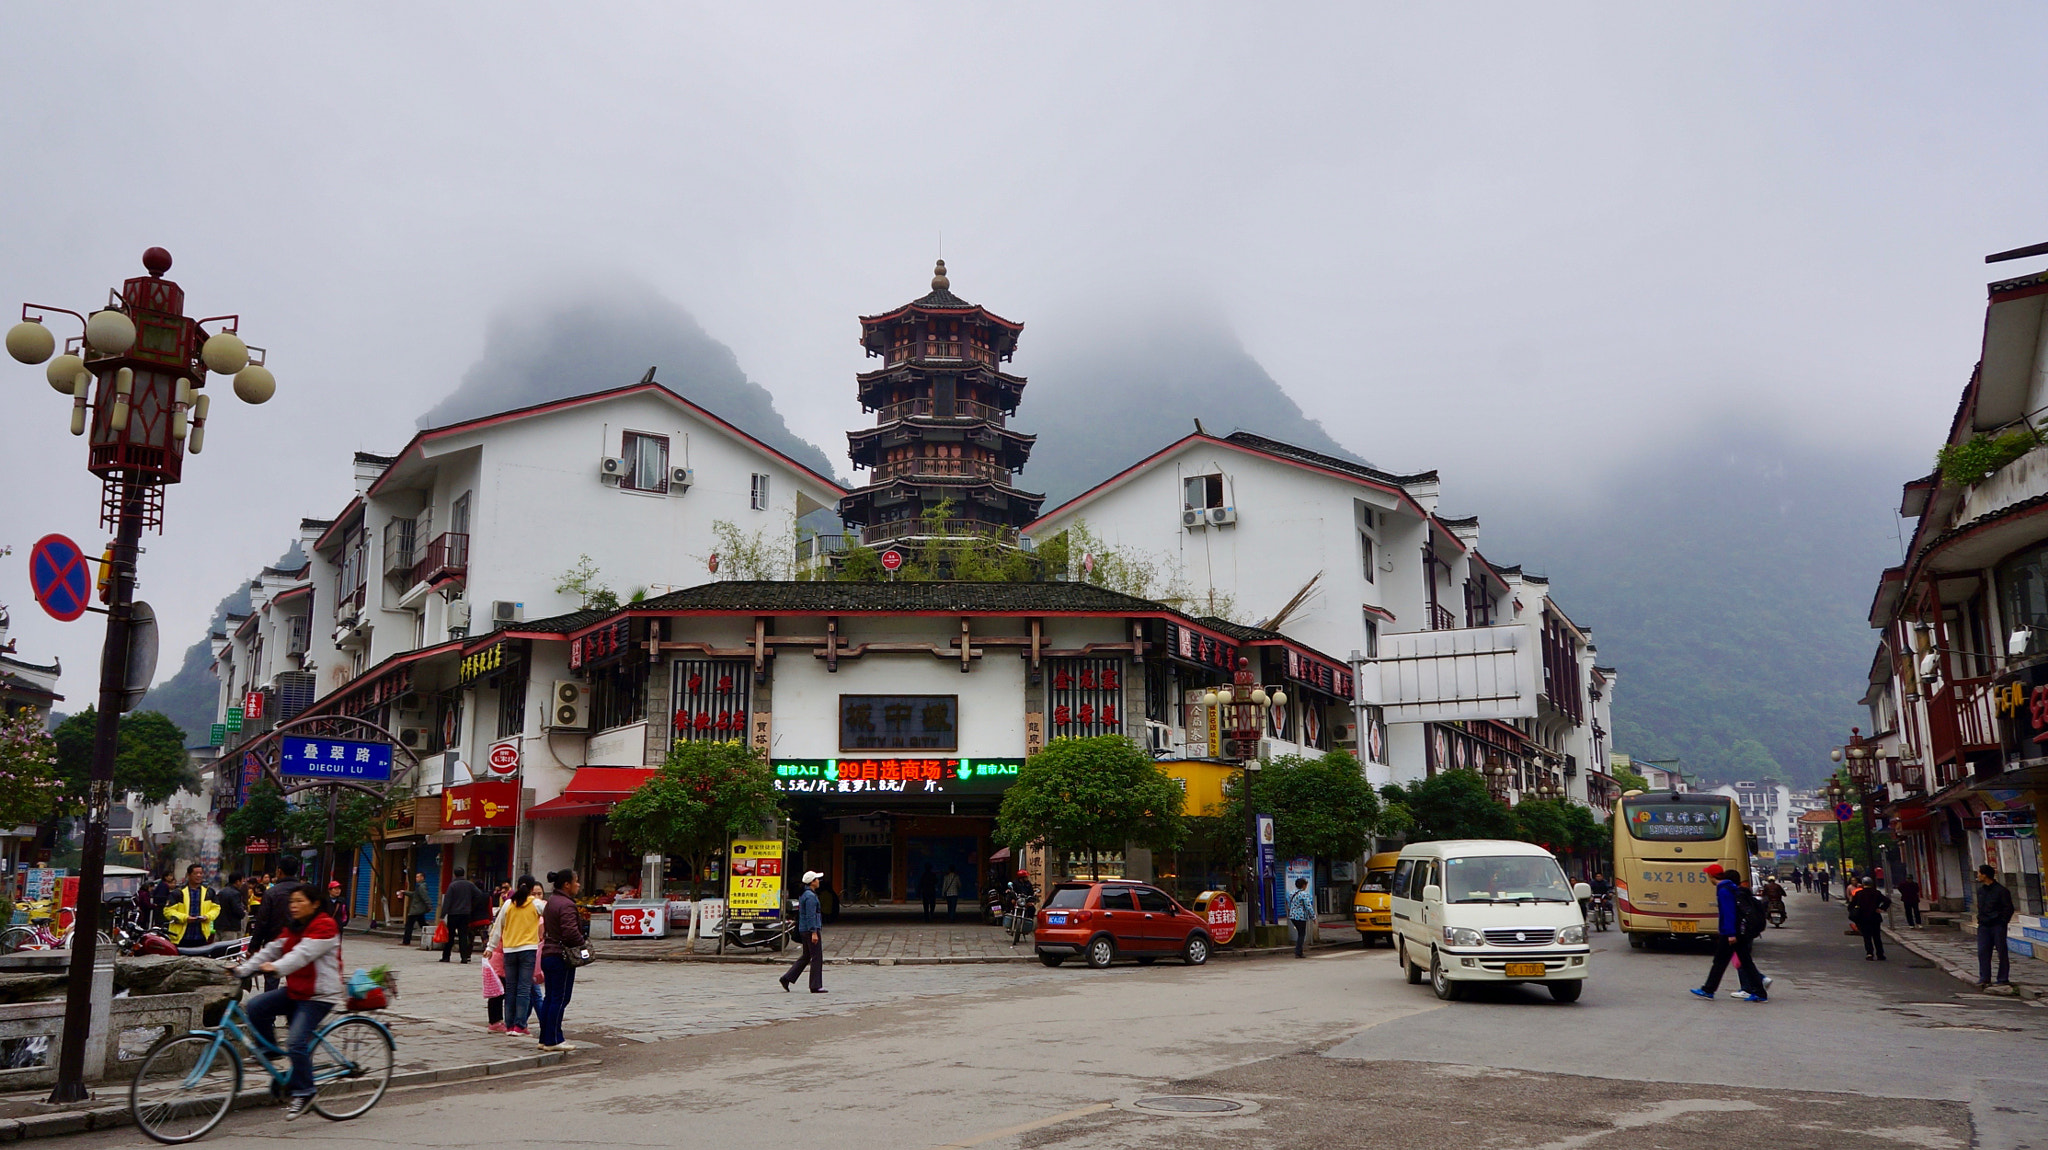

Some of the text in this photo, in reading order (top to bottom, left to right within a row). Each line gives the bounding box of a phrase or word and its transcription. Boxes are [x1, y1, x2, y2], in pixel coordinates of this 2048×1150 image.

[688, 673, 733, 696] 中华
[1053, 668, 1120, 690] 金龙寨
[672, 709, 746, 732] 餐饮名店
[1054, 703, 1120, 728] 家常菜
[303, 743, 371, 763] 叠翠路
[309, 763, 364, 774] DIECUI LU
[777, 764, 820, 776] 超市入口
[838, 760, 942, 781] 99自选商场
[976, 763, 1018, 776] 超市入口
[740, 878, 761, 889] 127
[1378, 897, 1384, 908] 1
